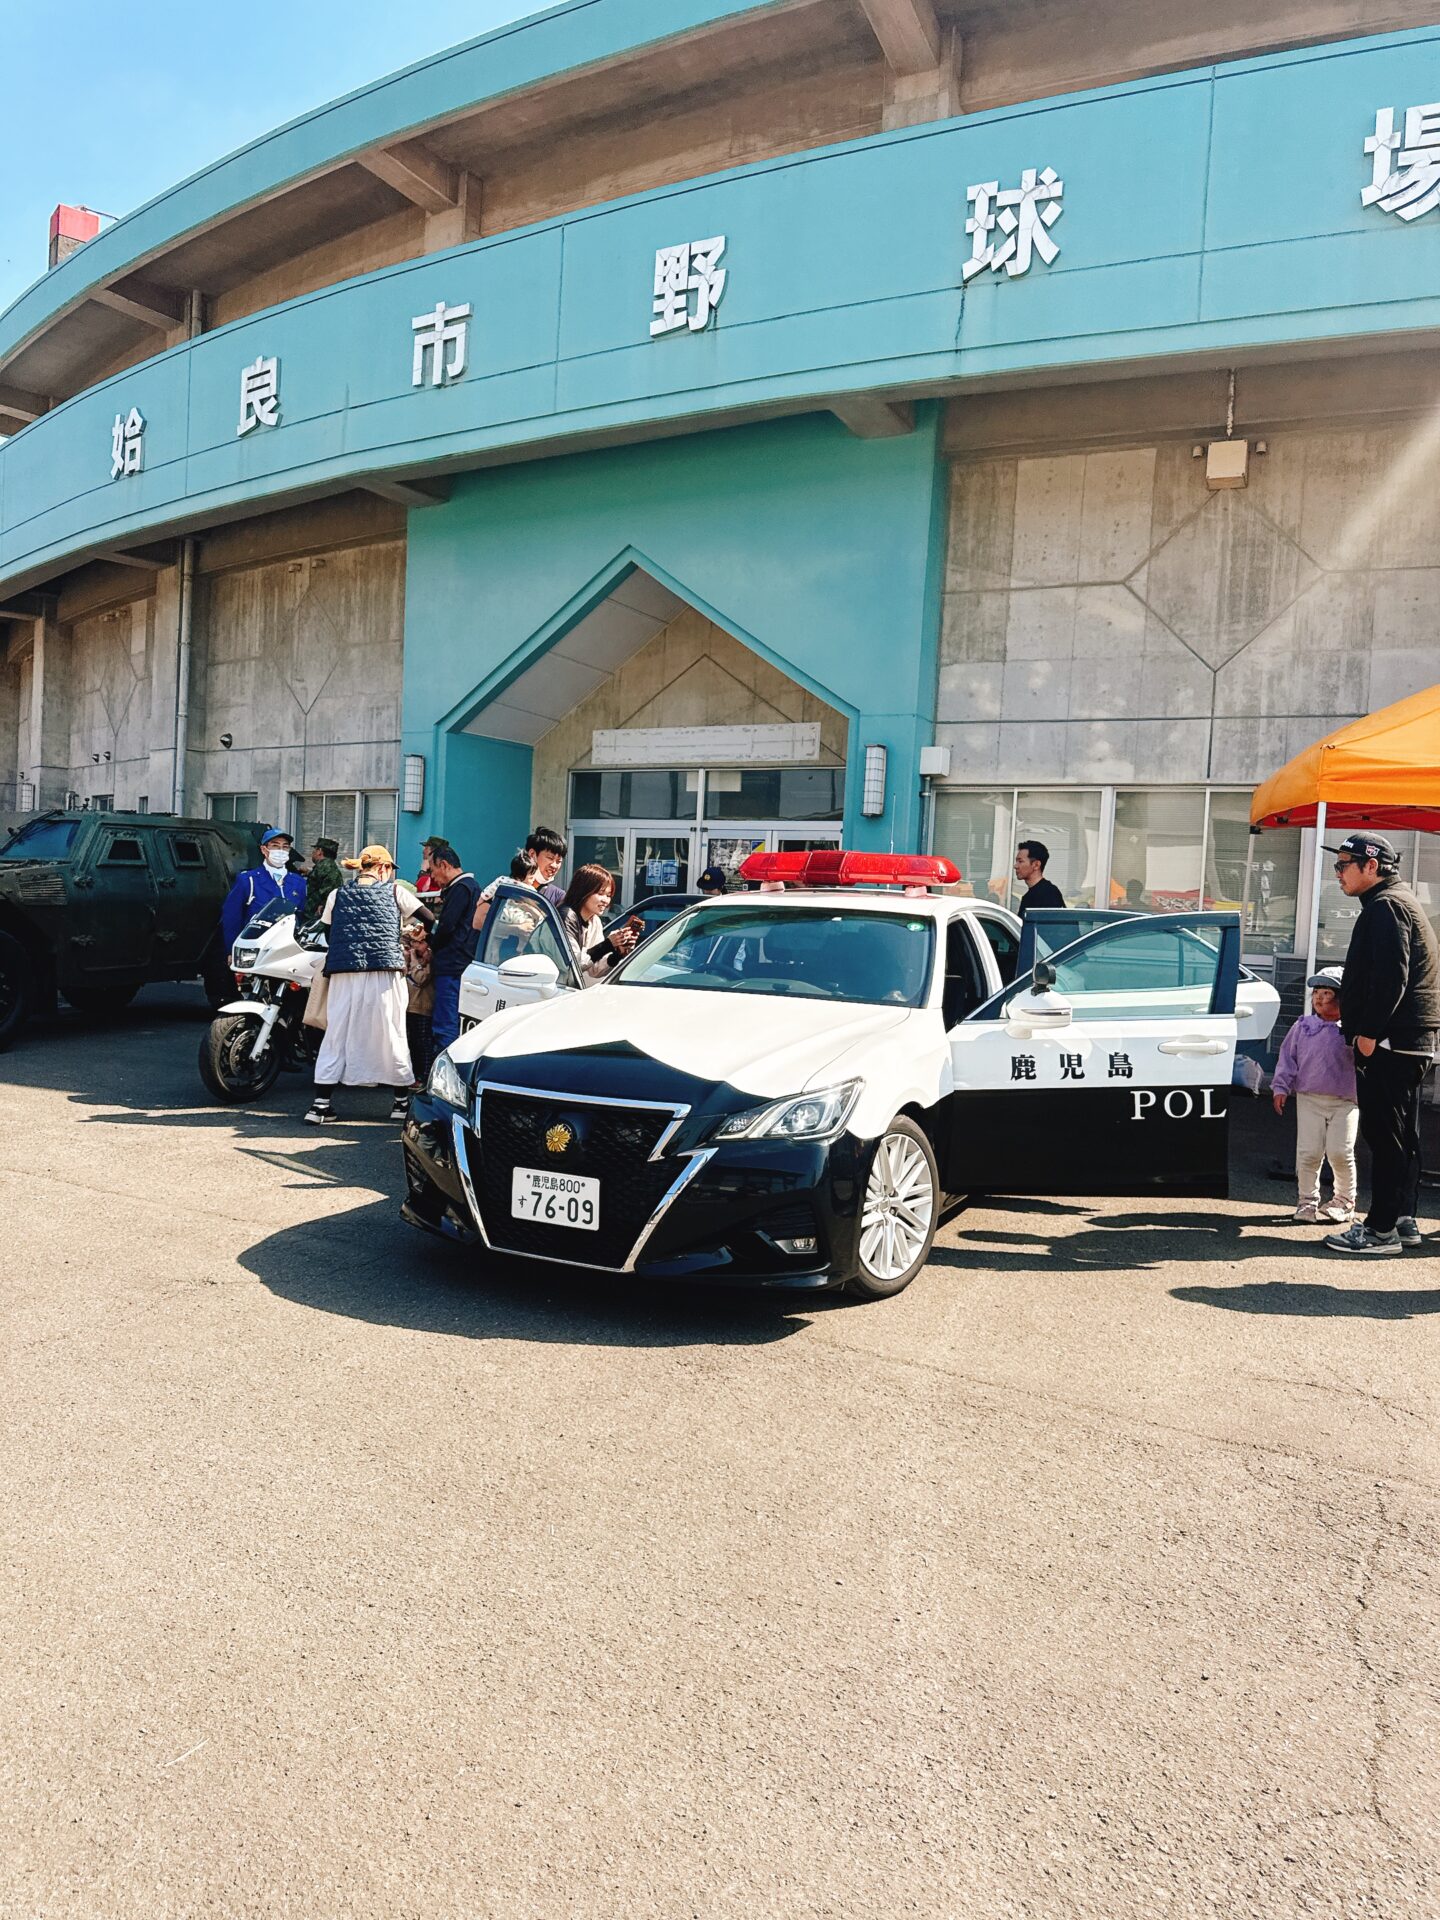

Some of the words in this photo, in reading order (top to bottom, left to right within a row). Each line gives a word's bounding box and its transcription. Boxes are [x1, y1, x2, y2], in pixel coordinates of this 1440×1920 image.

[1010, 1052, 1134, 1081] 鹿児島
[1130, 1088, 1227, 1120] POL
[531, 1191, 594, 1225] 76-09
